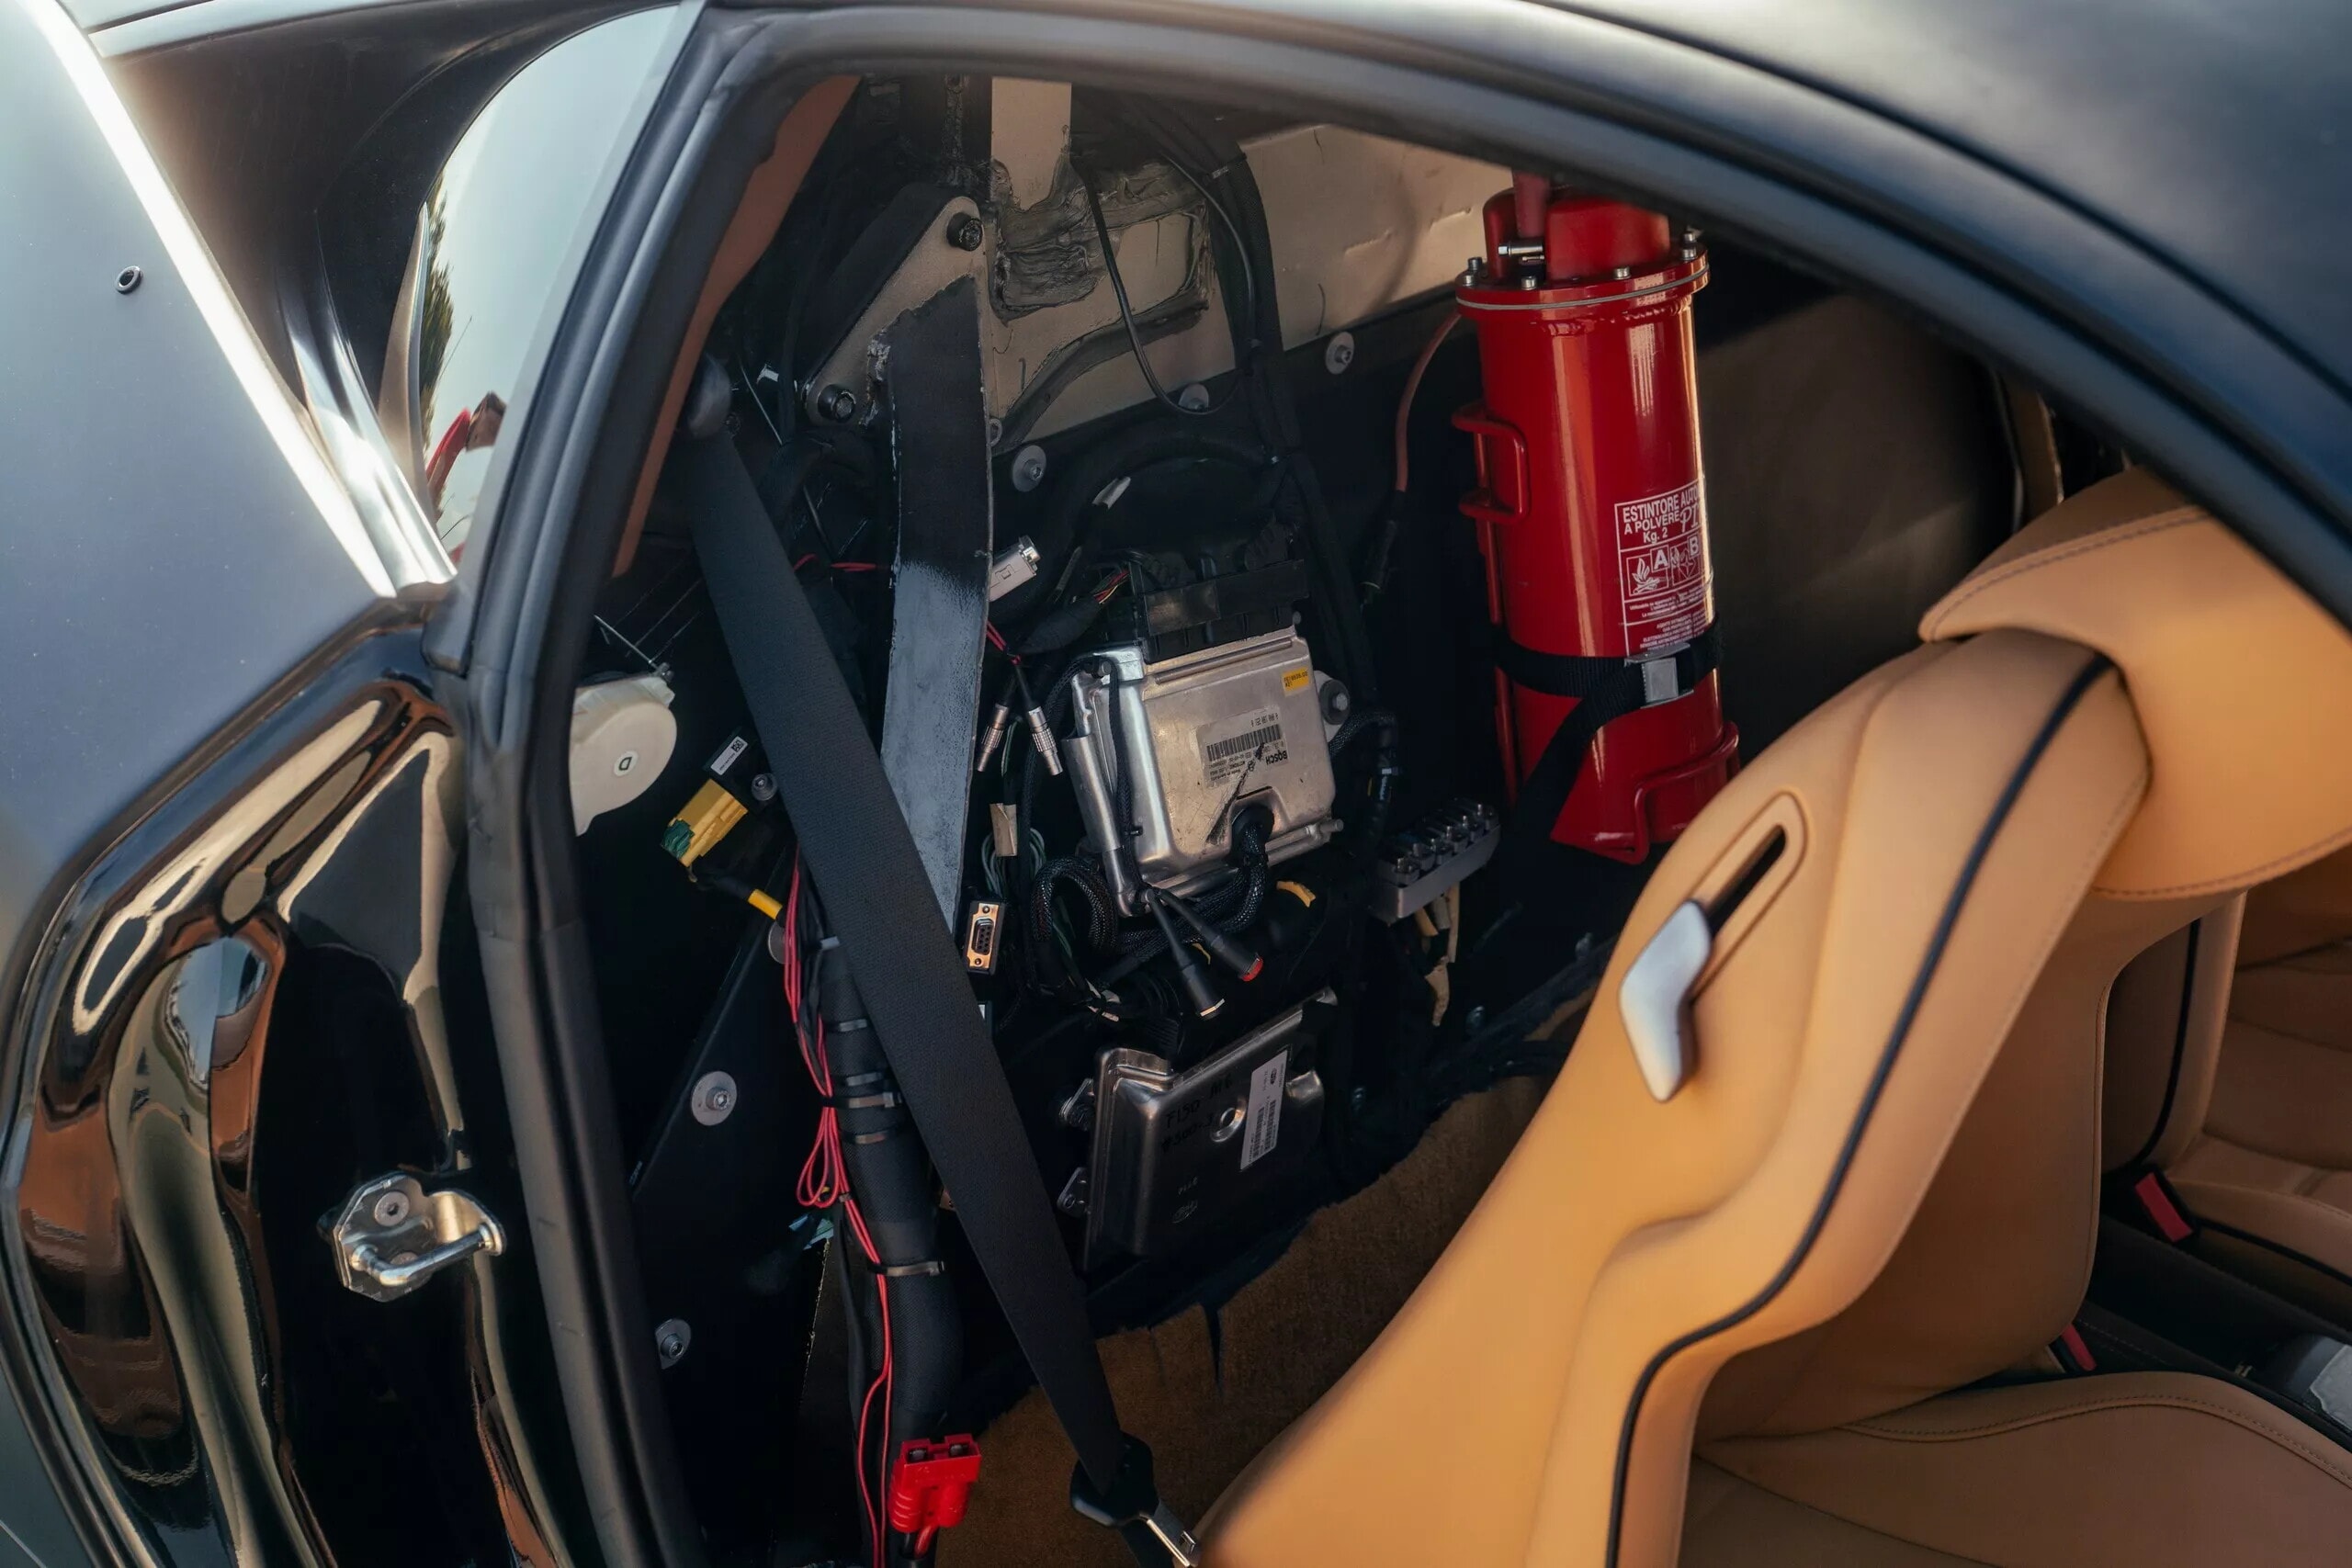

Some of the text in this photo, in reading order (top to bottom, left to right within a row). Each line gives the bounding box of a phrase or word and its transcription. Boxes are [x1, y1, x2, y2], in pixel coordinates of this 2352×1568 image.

[1623, 493, 1680, 524] ESTINTORE
[1624, 510, 1680, 536] A POLVERE
[1643, 526, 1668, 545] Kg. 2
[1689, 536, 1700, 556] B
[1654, 549, 1668, 570] A
[618, 756, 632, 771] D
[1265, 750, 1288, 766] BOSCH
